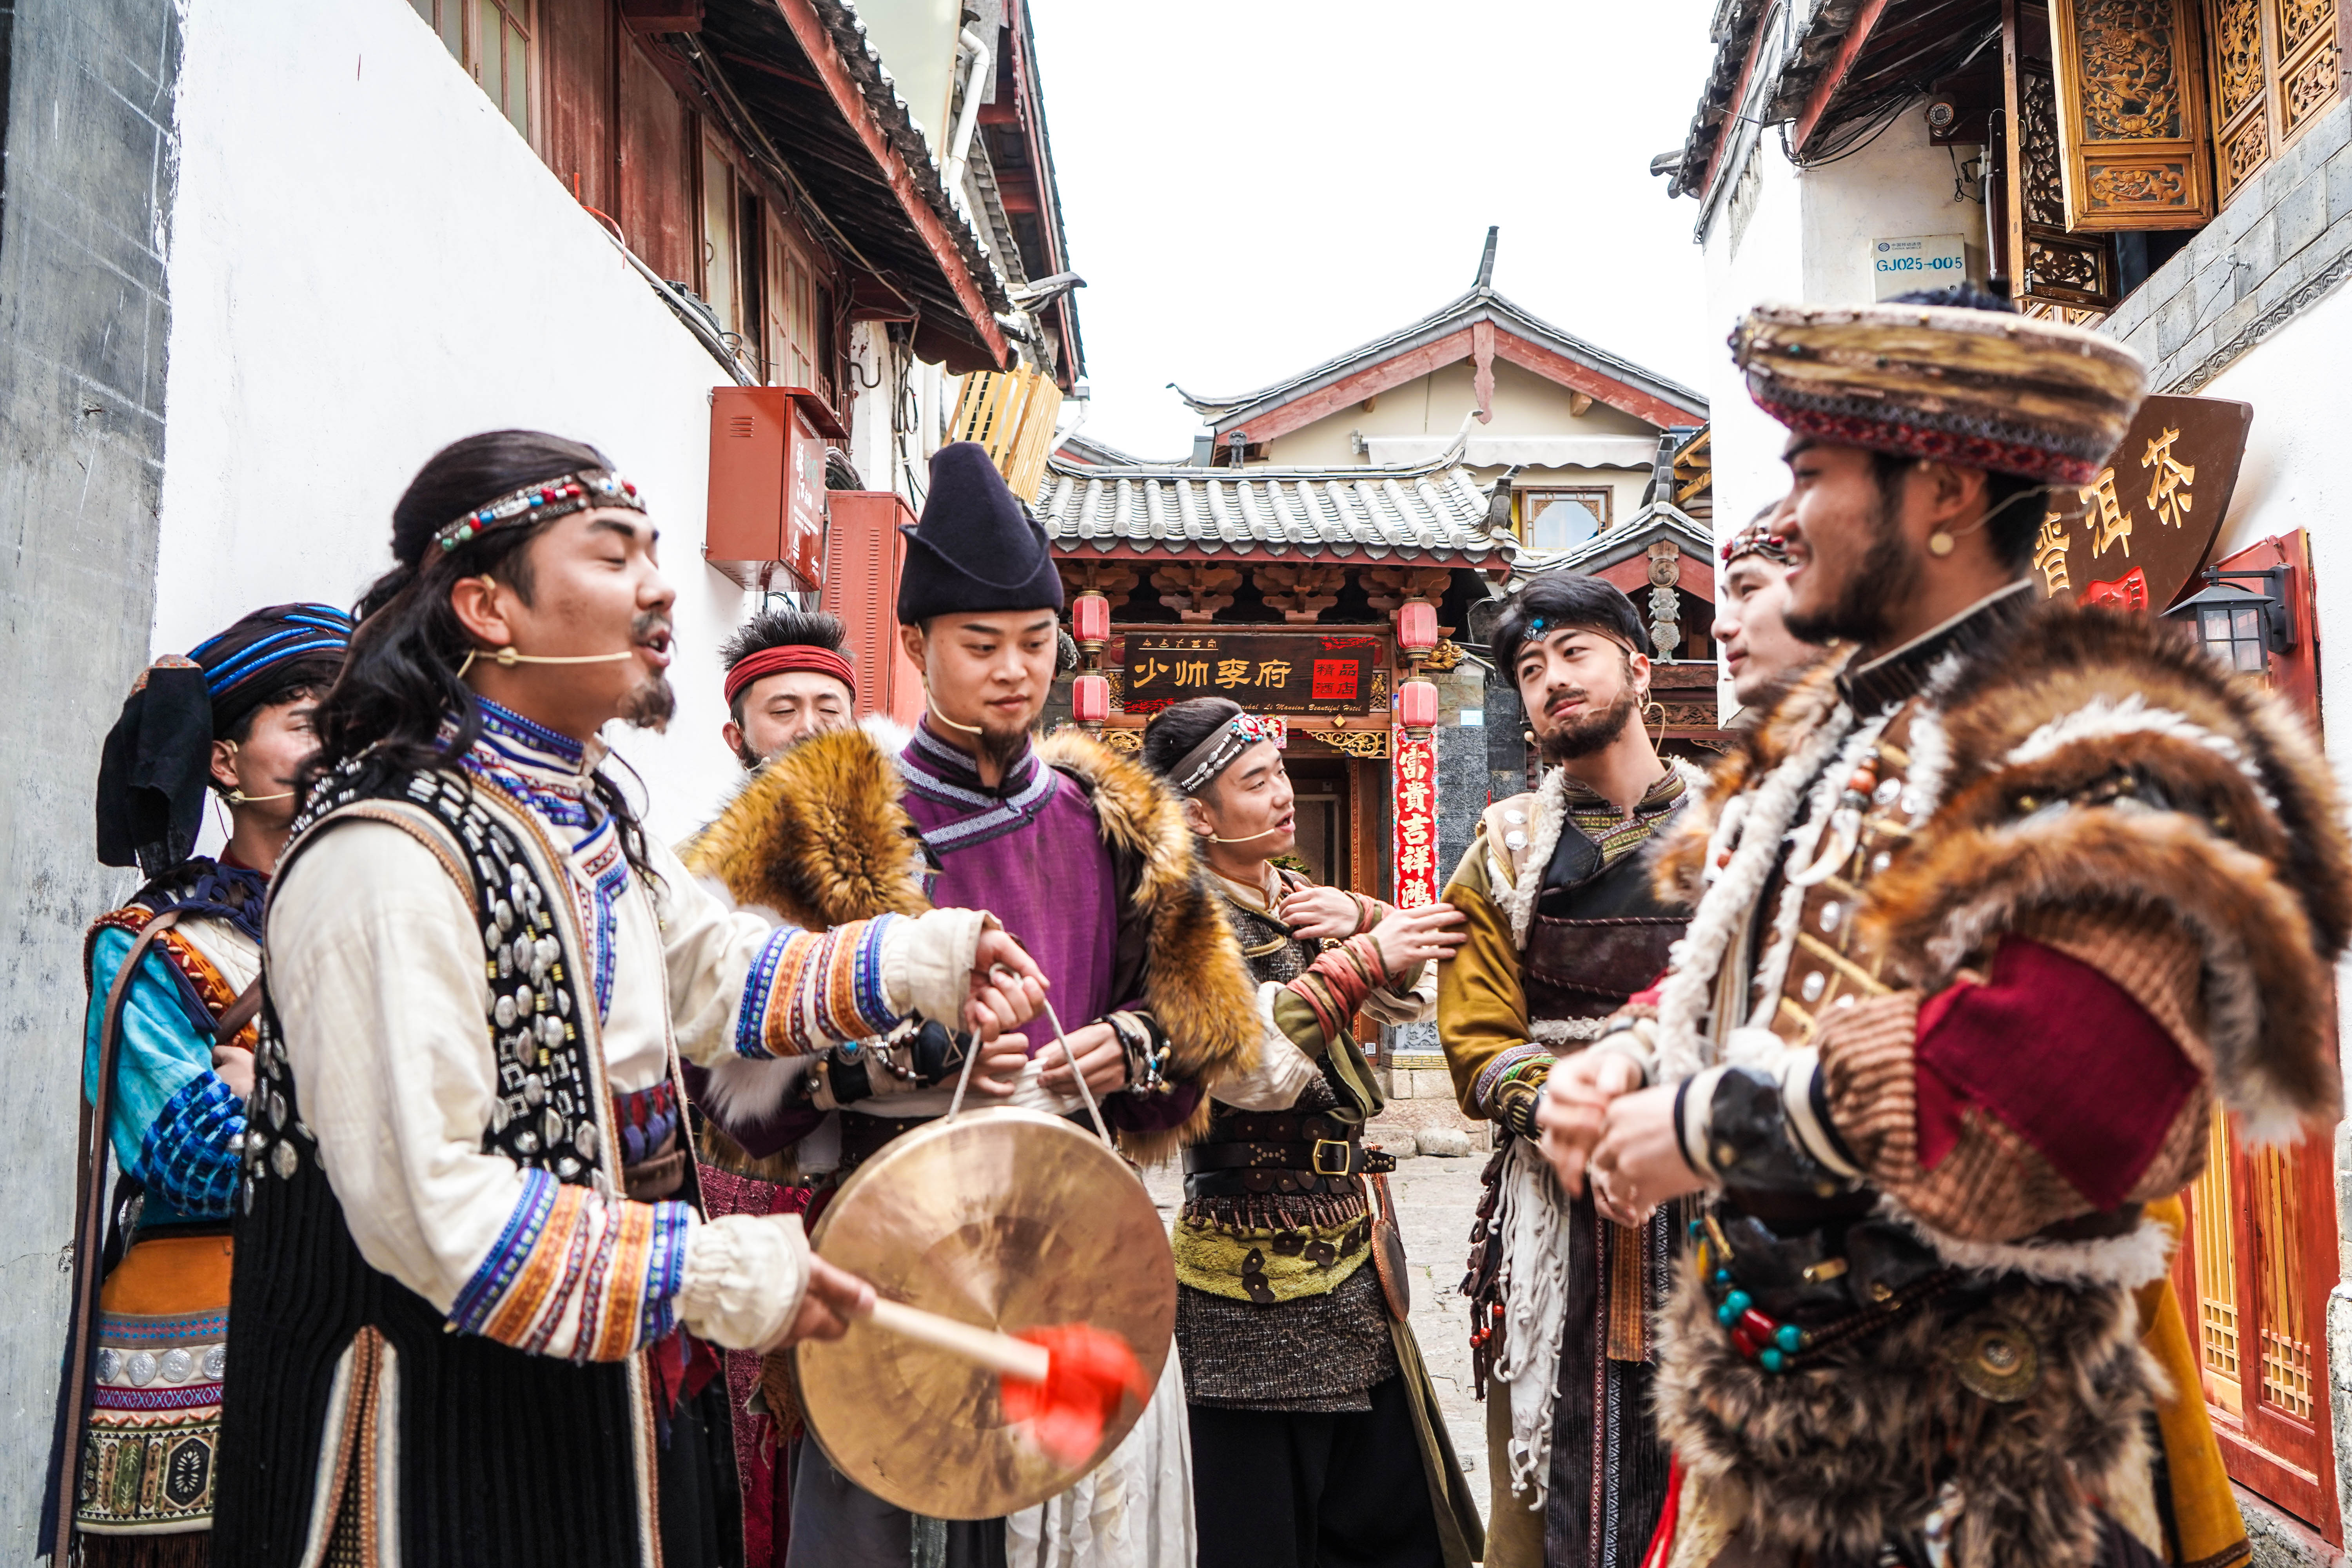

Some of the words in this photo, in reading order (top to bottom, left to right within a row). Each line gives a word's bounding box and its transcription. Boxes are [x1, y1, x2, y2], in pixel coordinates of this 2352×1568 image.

[2033, 426, 2195, 599] 普洱茶
[1134, 657, 1292, 689] 少帅李府
[1316, 663, 1357, 677] 精品
[1316, 682, 1356, 694] 酒店
[1308, 704, 1340, 713] Beautiful
